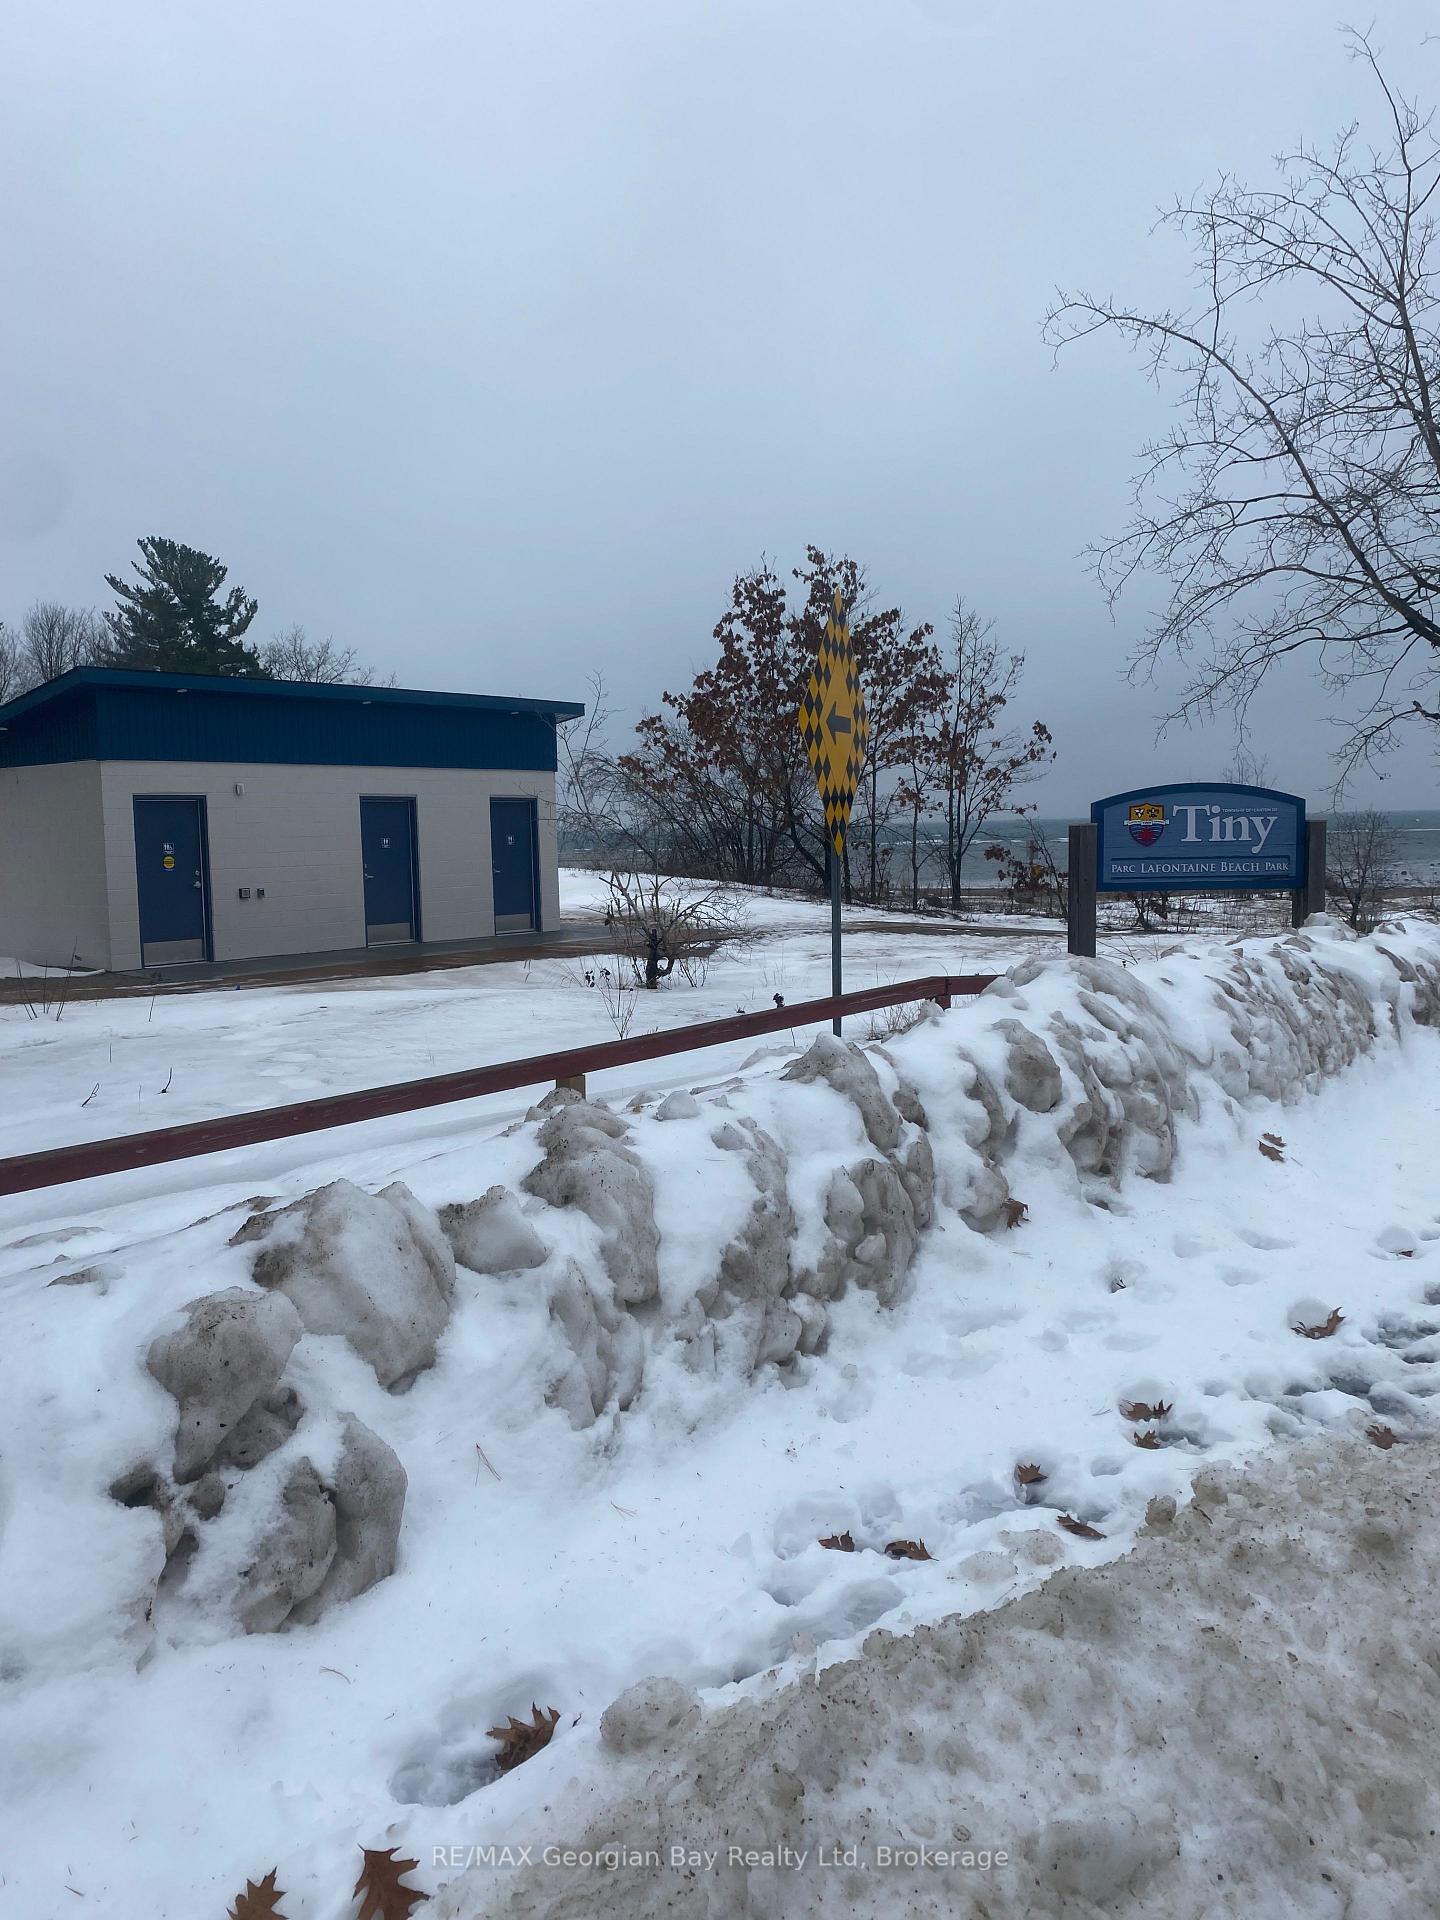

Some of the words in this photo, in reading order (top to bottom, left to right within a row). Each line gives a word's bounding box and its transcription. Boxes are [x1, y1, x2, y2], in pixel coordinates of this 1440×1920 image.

[1172, 804, 1279, 854] Tiny
[1111, 864, 1136, 873] PARC
[1141, 863, 1216, 873] LAFONTAINE
[1221, 861, 1260, 872] BEACH
[1265, 861, 1289, 871] PARK
